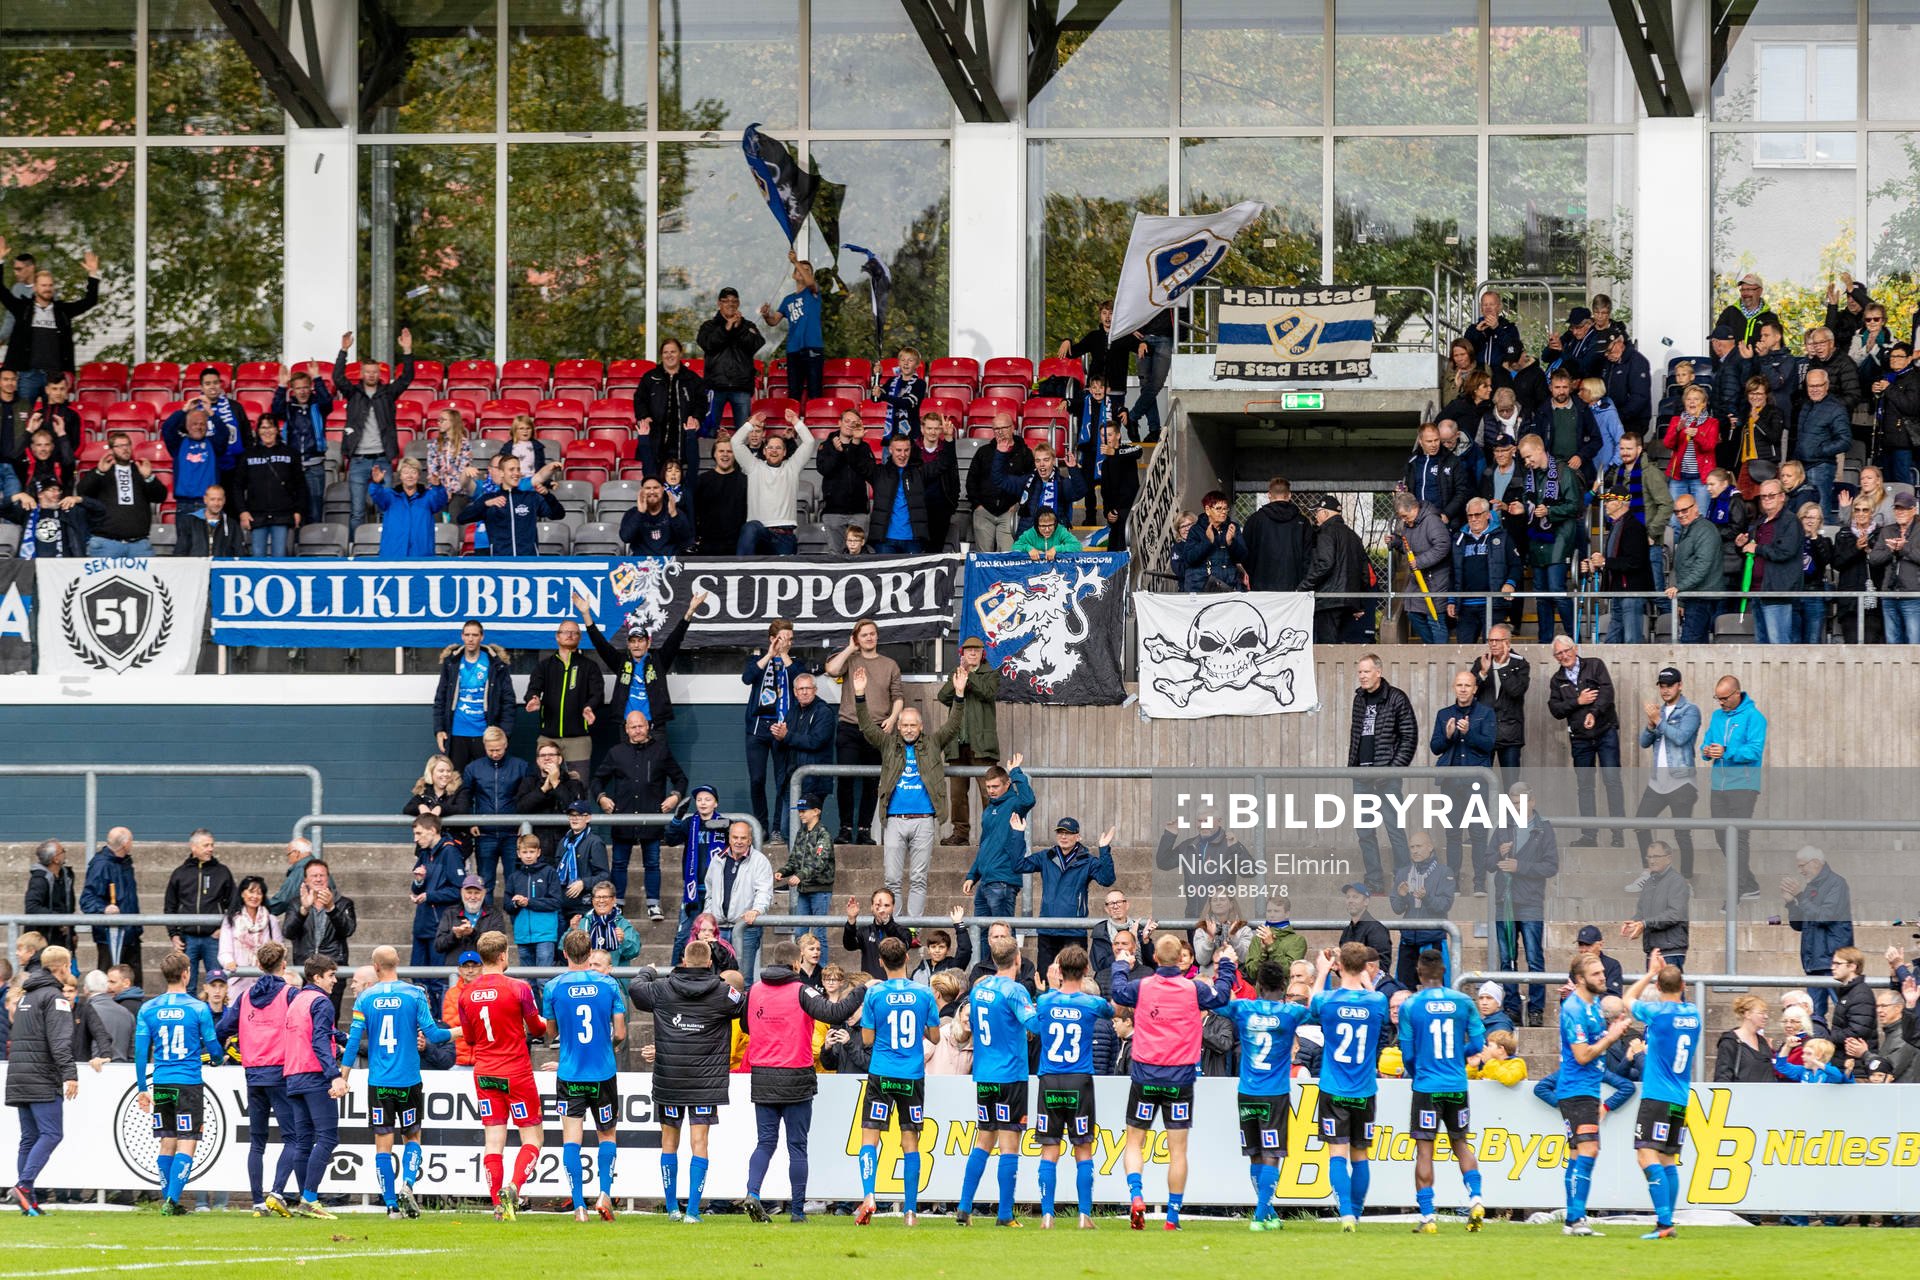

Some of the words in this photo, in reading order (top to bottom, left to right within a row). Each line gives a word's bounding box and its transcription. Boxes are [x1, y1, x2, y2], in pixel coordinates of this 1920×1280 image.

[1223, 286, 1372, 306] Halmstad
[1215, 362, 1235, 377] En
[1245, 362, 1291, 377] Stad
[1298, 362, 1329, 376] Ett
[1336, 361, 1370, 378] Lag
[84, 557, 148, 576] SEKTION
[219, 574, 606, 618] BOLLKLUBBEN
[692, 566, 949, 619] SUPPORT
[95, 597, 139, 637] 51
[375, 998, 400, 1008] EAB
[473, 990, 495, 1000] EAB
[570, 986, 596, 996] EAB
[888, 994, 914, 1004] EAB
[1429, 1002, 1455, 1012] EAB
[160, 1010, 183, 1019] EAB
[479, 1006, 495, 1042] 1
[576, 1004, 593, 1044] 3
[887, 1010, 916, 1049] 19
[977, 1006, 991, 1046] 5
[1053, 1009, 1080, 1019] EAB
[1341, 1008, 1367, 1018] EAB
[158, 1025, 188, 1060] 14
[378, 1015, 397, 1054] 4
[1048, 1022, 1082, 1063] 23
[1254, 1032, 1273, 1070] 2
[1333, 1023, 1368, 1064] 21
[1429, 1019, 1454, 1059] 11
[1672, 1034, 1691, 1074] 6
[1478, 1127, 1570, 1181] Byg
[1763, 1129, 1892, 1166] Nidles
